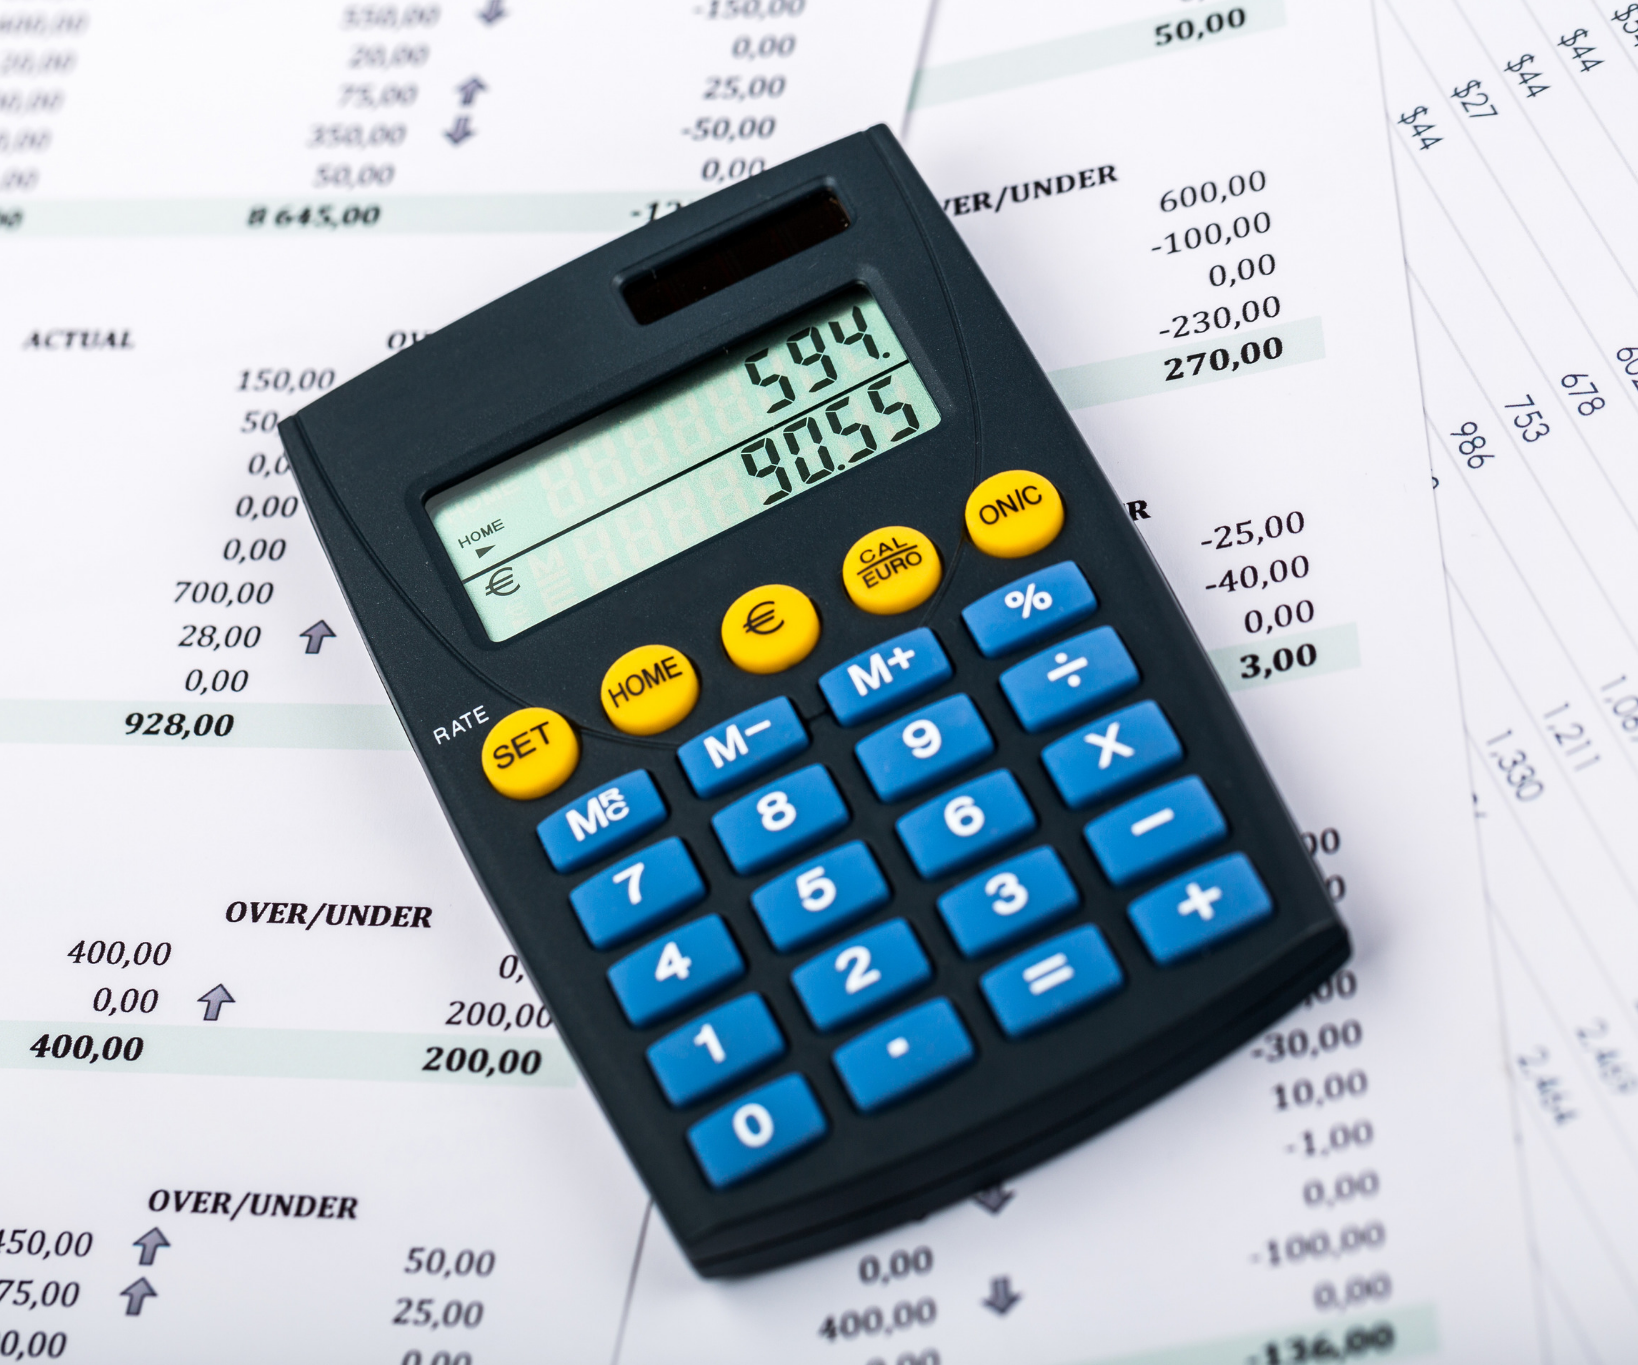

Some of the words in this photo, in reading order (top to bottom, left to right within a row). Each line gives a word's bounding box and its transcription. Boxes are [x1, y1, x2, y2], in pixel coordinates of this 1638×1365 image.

[1155, 7, 1247, 46] 50,00
[732, 33, 796, 61] 0,00
[1557, 29, 1605, 73] $44
[703, 74, 786, 102] 25,00
[1504, 54, 1551, 98] $44
[337, 82, 419, 111] 75,00
[1451, 79, 1498, 118] $27
[682, 115, 776, 143] -50,00
[1397, 106, 1444, 150] $44
[312, 163, 396, 190] 50,00
[1160, 170, 1267, 213] 600,00
[1151, 211, 1272, 255] -100,00
[1209, 253, 1277, 288] 0,00
[1159, 295, 1281, 339] -230,00
[22, 328, 135, 351] ACTUAL
[1164, 336, 1284, 381] 270,00
[237, 367, 336, 395] 150,00
[1561, 373, 1606, 416] 678
[1504, 394, 1550, 442] 753
[741, 375, 920, 506] 90.55
[1450, 421, 1495, 469] 986
[235, 495, 299, 521] 0,00
[978, 485, 1043, 526] ON/C
[458, 518, 505, 549] HOME
[1201, 511, 1305, 549] -25,00
[223, 537, 286, 564] 0,00
[859, 537, 908, 565] CAL
[861, 550, 923, 589] EURO
[1205, 555, 1309, 592] -40,00
[174, 581, 274, 607] 700,00
[1004, 583, 1053, 619] %
[743, 600, 785, 635] €
[1244, 600, 1315, 635] 0,00
[177, 624, 261, 652] 28,00
[847, 647, 916, 697] M+
[1240, 644, 1317, 679] 3,00
[185, 669, 248, 695] 0,00
[608, 656, 683, 708] HOME
[124, 712, 234, 740] 928,00
[432, 705, 490, 745] RATE
[902, 719, 942, 759] 9
[492, 721, 552, 769] SET
[756, 791, 797, 831] 8
[944, 795, 985, 837] 6
[612, 862, 645, 905] 7
[796, 866, 837, 912] 5
[984, 872, 1029, 915] 3
[225, 900, 433, 931] OVER/UNDER
[67, 940, 172, 969] 400,00
[654, 942, 692, 981] 4
[834, 945, 881, 994] 2
[93, 987, 158, 1017] 0,00
[445, 1000, 553, 1031] 200,00
[30, 1034, 144, 1064] 400,00
[693, 1023, 726, 1064] 1
[1252, 1019, 1363, 1063] -30,00
[421, 1046, 542, 1078] 200,00
[1271, 1068, 1369, 1112] 10,00
[732, 1103, 774, 1148] 0
[1285, 1118, 1374, 1158] -1,00
[148, 1188, 358, 1221] OVER/UNDER
[1303, 1169, 1380, 1210] 0,00
[1250, 1219, 1386, 1267] -100,00
[404, 1246, 496, 1280] 50,00
[858, 1246, 933, 1287] 0,00
[392, 1297, 484, 1332] 25,00
[818, 1297, 937, 1342] 400,00
